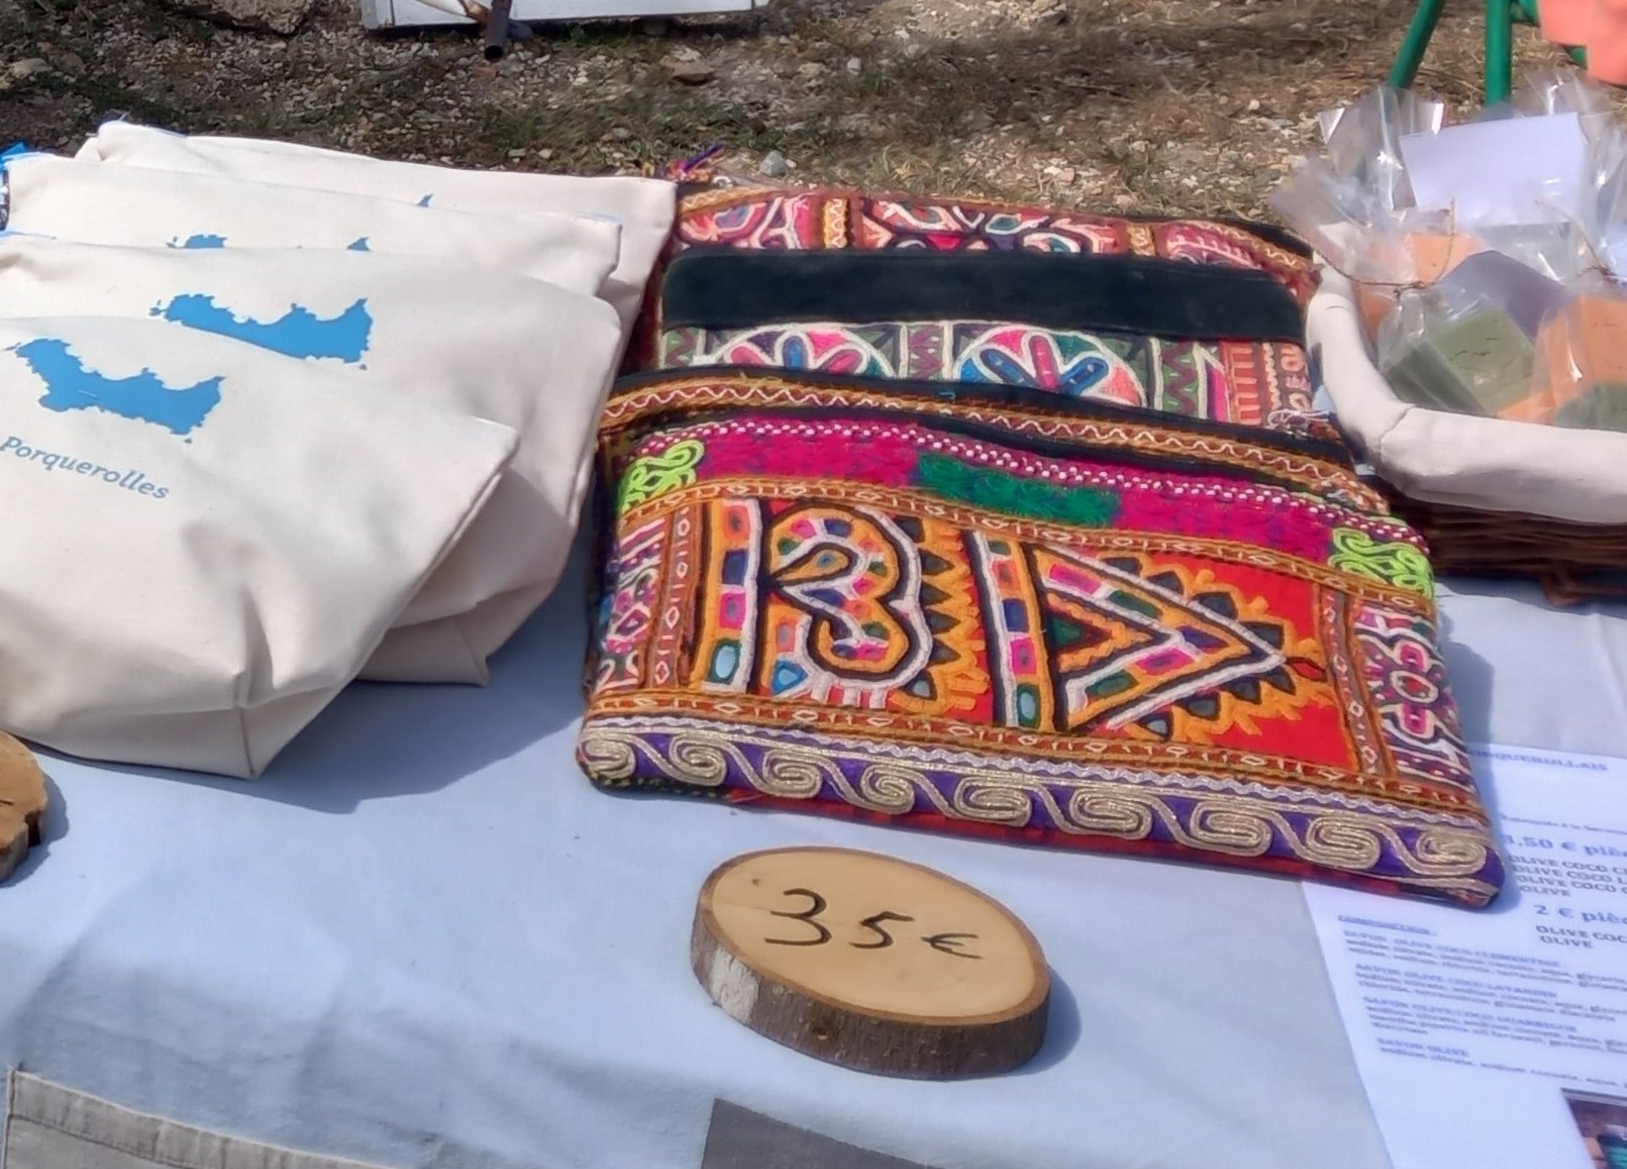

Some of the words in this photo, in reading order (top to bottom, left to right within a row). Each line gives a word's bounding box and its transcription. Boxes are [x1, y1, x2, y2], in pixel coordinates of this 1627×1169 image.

[1508, 855, 1559, 867] OLIVE
[1562, 861, 1609, 873] COCO
[1512, 864, 1563, 877] OLIVE
[1566, 870, 1613, 883] COCO
[1517, 874, 1568, 887] OLIVE
[1570, 880, 1617, 893] COCO
[1519, 884, 1572, 898] OLIVE
[764, 888, 985, 960] 35€
[1535, 925, 1591, 939] OLIVE
[1539, 935, 1593, 949] OLIVE
